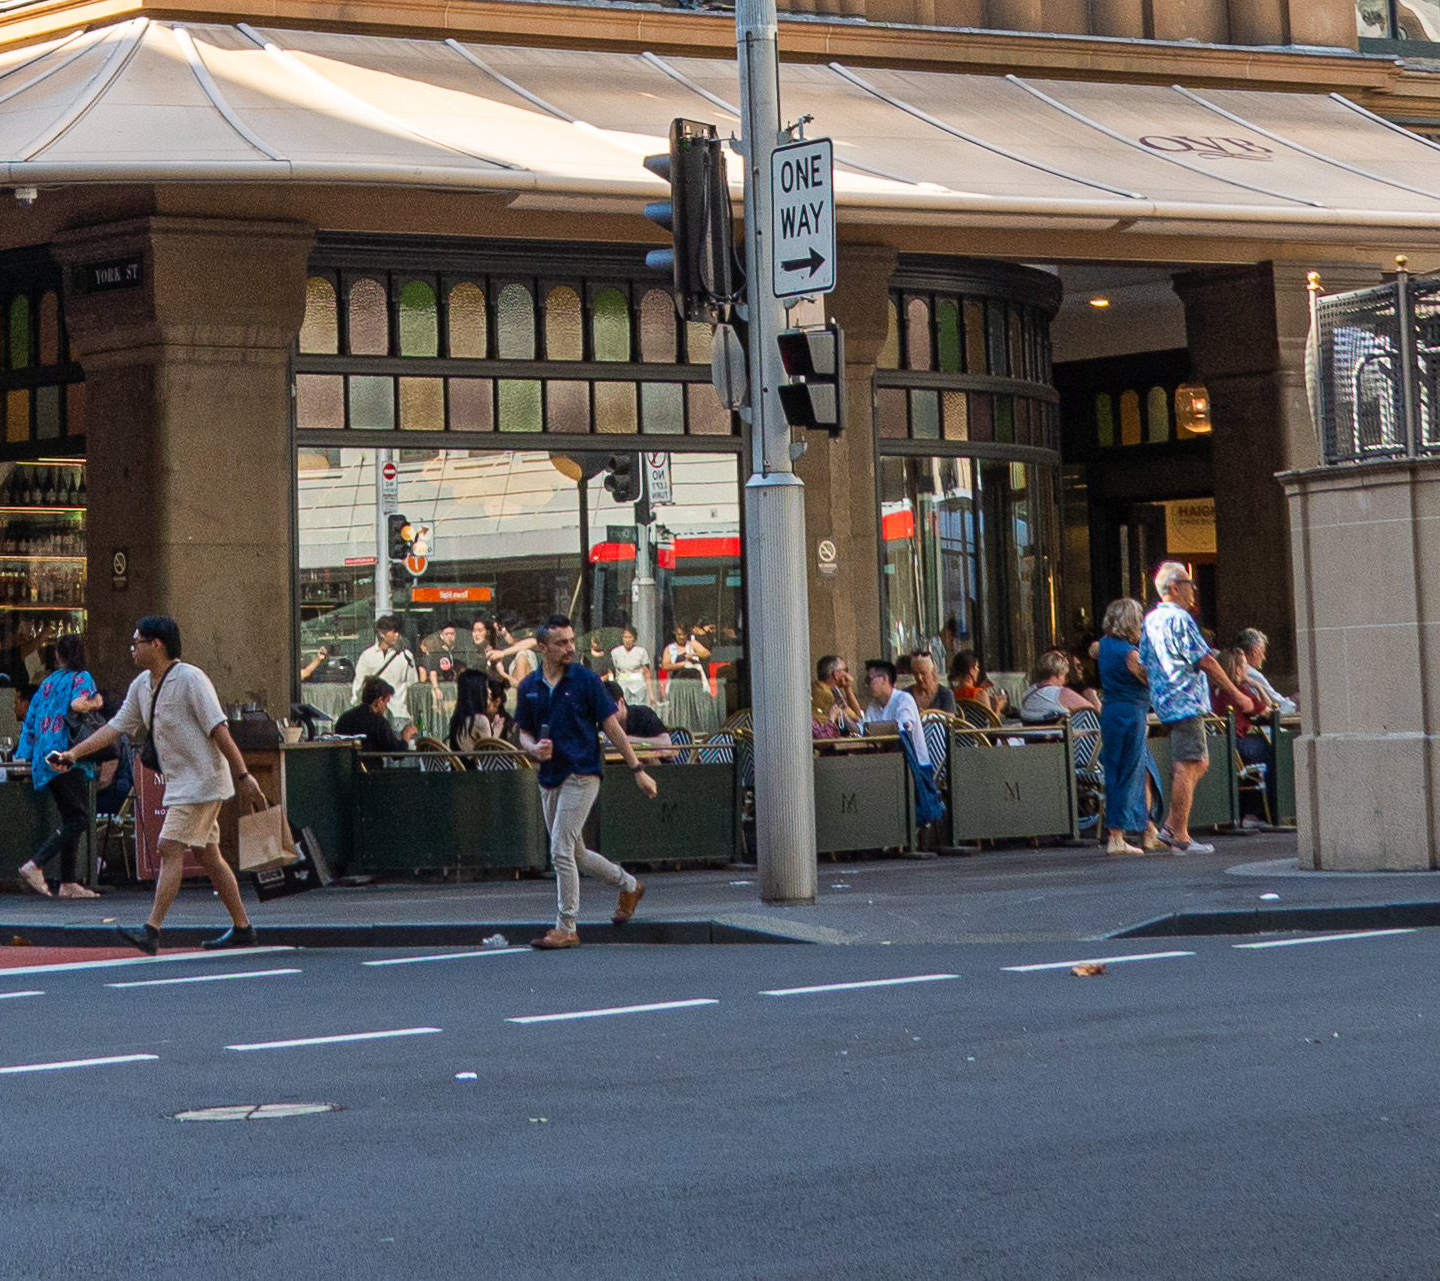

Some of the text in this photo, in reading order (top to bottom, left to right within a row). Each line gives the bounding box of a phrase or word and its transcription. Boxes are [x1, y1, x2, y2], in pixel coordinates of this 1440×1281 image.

[781, 154, 823, 193] ONE
[781, 200, 824, 239] WAY
[96, 264, 137, 284] YORK ST
